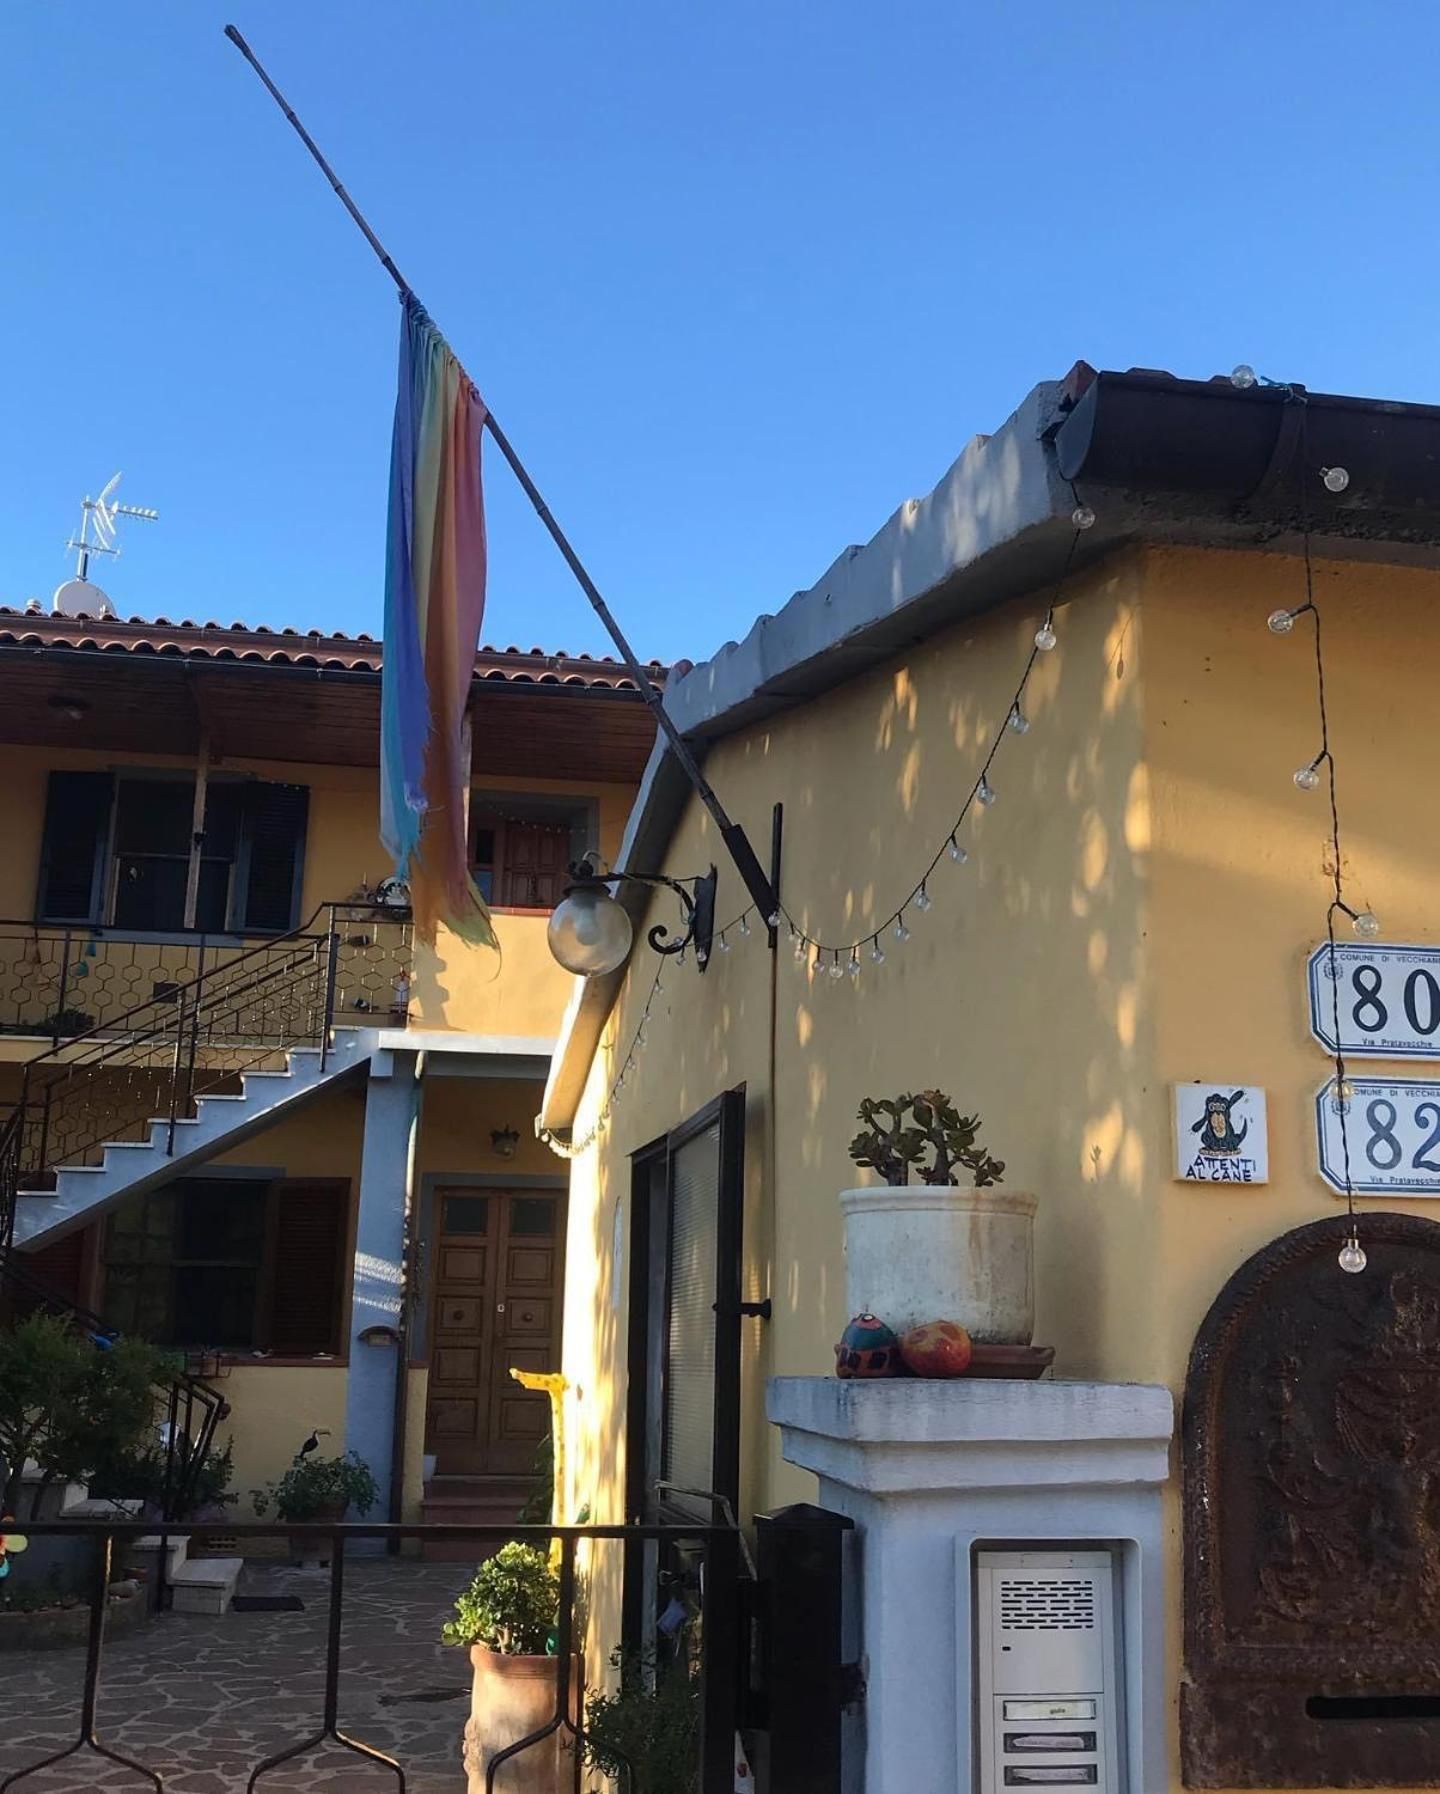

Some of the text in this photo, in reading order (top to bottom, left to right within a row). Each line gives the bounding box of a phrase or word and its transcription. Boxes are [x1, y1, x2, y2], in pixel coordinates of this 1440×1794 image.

[1340, 953, 1375, 962] COMUNE
[1381, 955, 1391, 963] DI
[1352, 964, 1440, 1036] 80
[1361, 1038, 1375, 1046] Via
[1351, 1087, 1383, 1097] OMUNE
[1389, 1089, 1399, 1097] DI
[1366, 1098, 1440, 1172] 82
[1193, 1155, 1257, 1172] ATTENTI
[1185, 1164, 1252, 1182] AL CANE
[1369, 1175, 1384, 1184] Via
